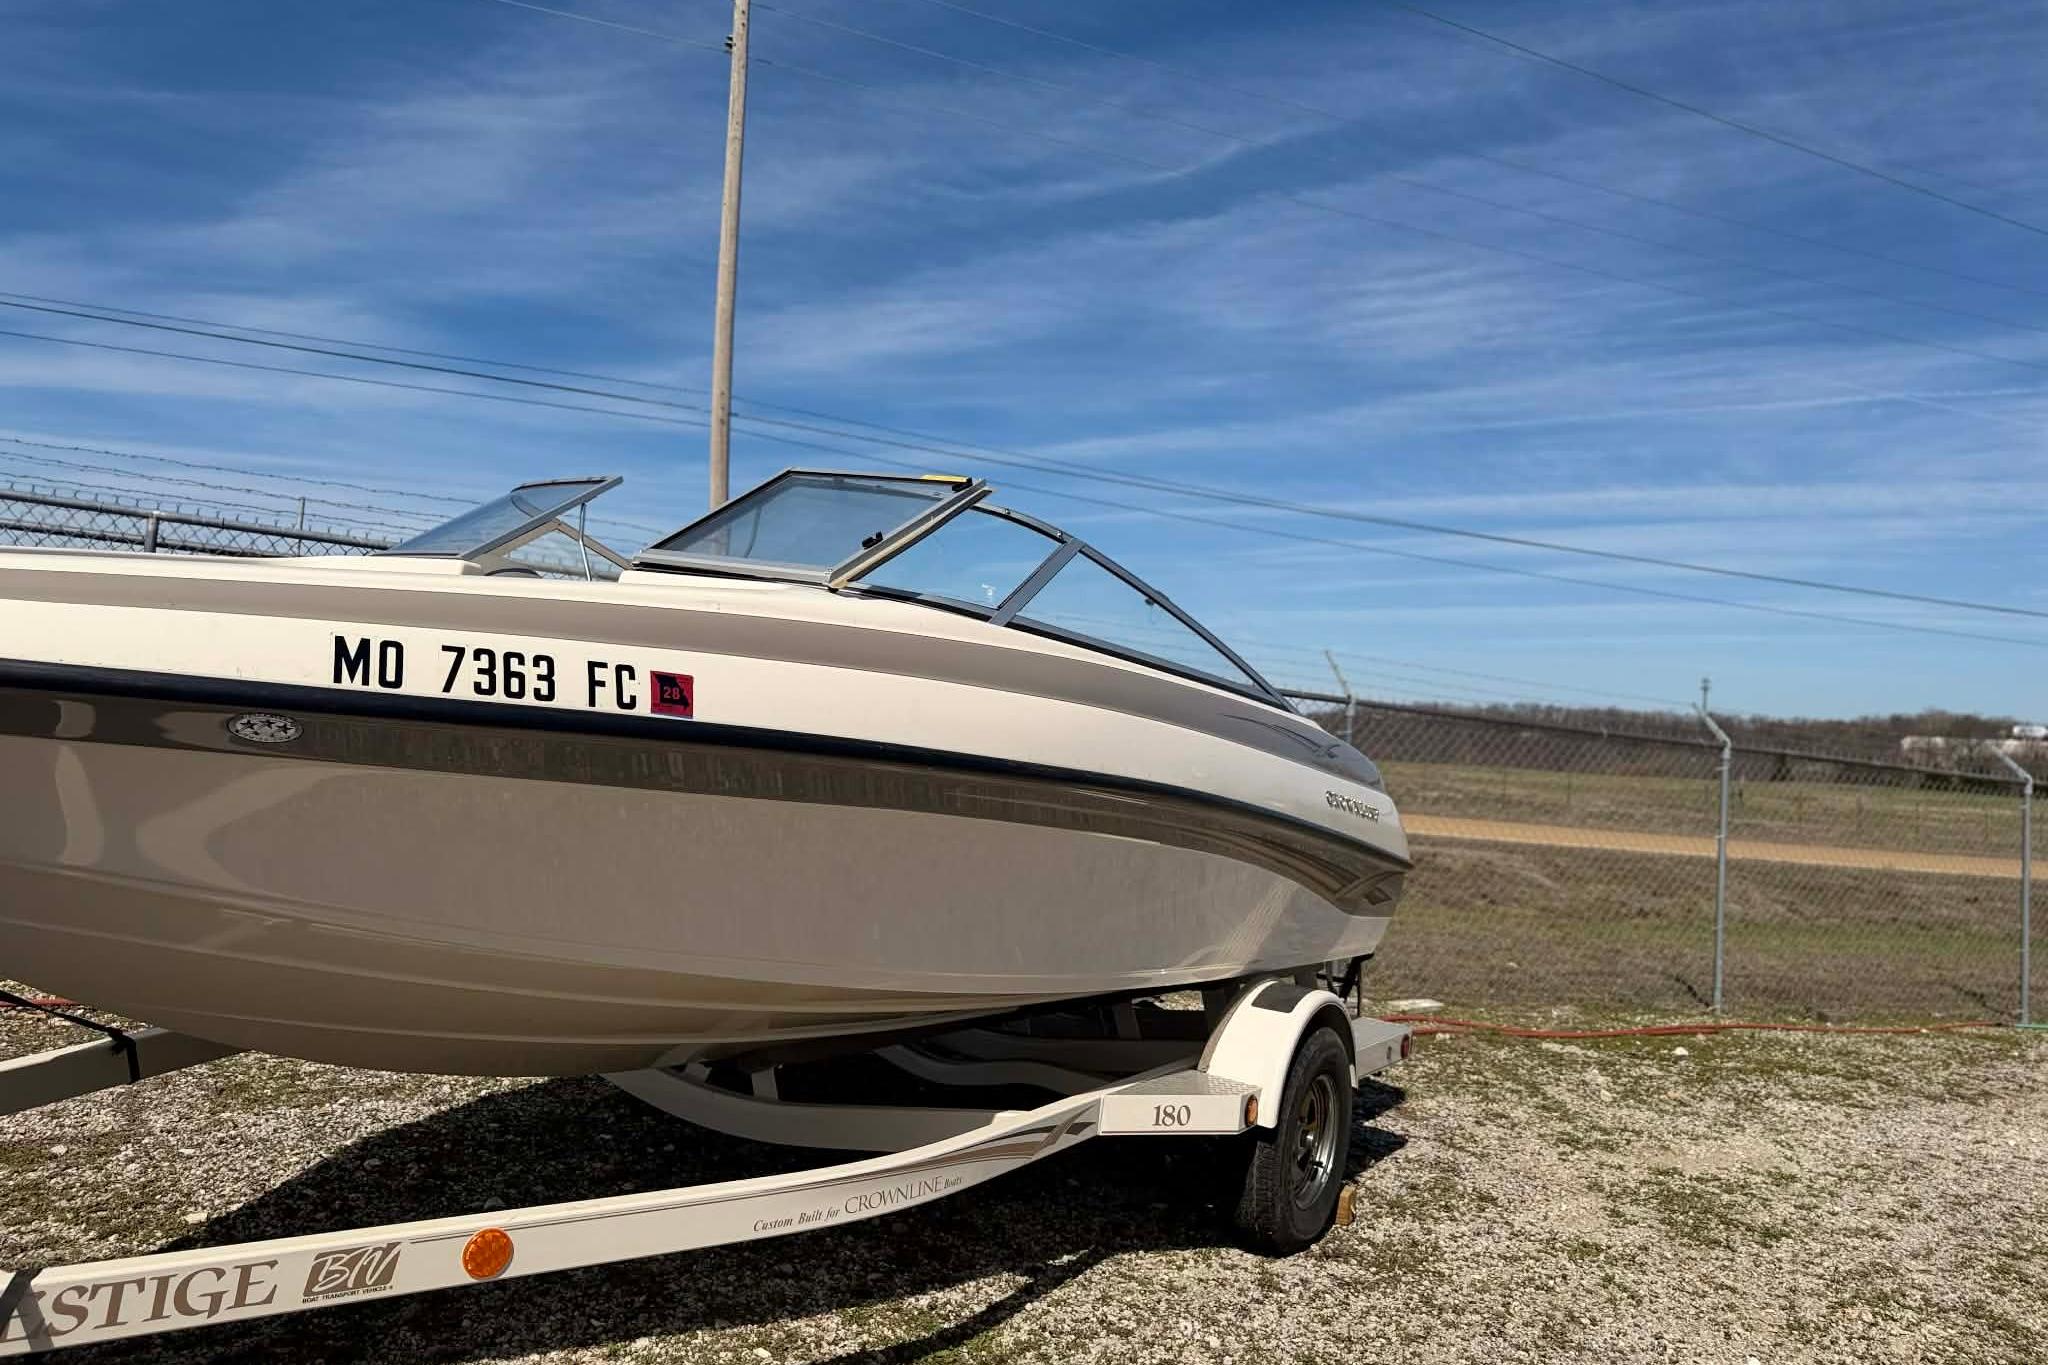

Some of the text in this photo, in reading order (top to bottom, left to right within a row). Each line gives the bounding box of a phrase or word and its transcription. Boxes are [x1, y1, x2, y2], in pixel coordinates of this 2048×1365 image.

[333, 635, 637, 710] MO 7363 FC
[663, 686, 681, 700] 28
[1152, 1104, 1191, 1127] 180
[753, 1218, 793, 1232] Custom
[798, 1208, 824, 1225] Built
[823, 1206, 840, 1221] for
[844, 1176, 942, 1214] CROWNLINE
[322, 1289, 361, 1300] TRANSPORT
